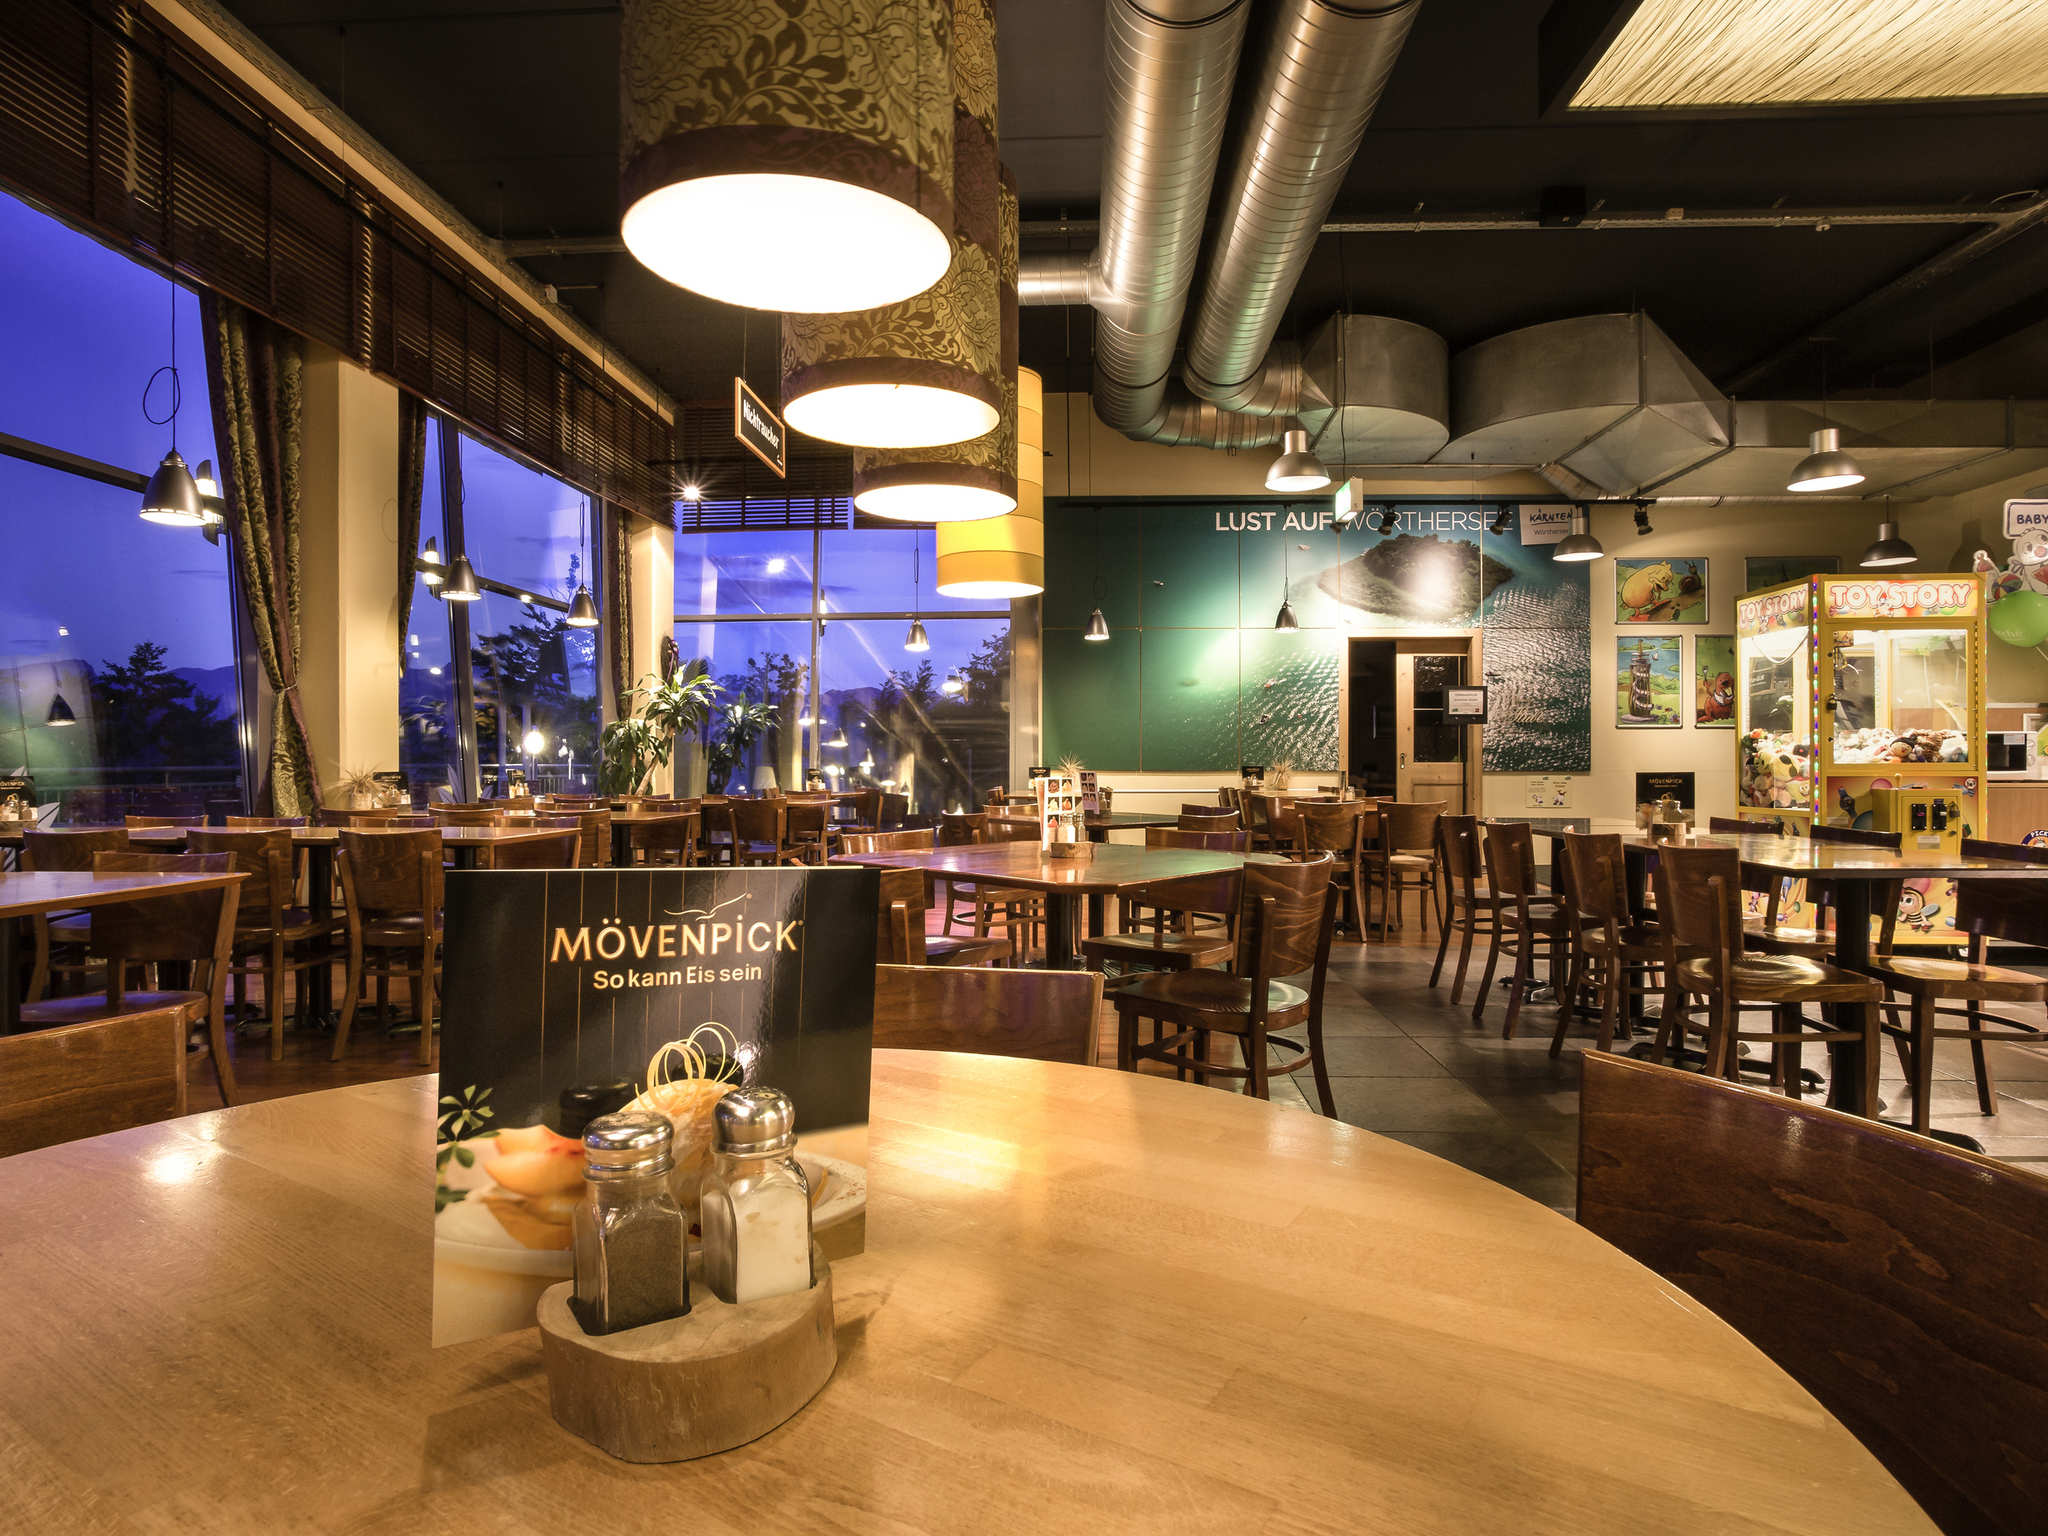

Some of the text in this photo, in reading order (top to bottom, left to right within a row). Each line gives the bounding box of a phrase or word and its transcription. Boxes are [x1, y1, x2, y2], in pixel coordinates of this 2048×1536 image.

[1215, 511, 1277, 531] LUST
[1282, 511, 1334, 531] AUF
[1740, 588, 1807, 623] TOY STORY
[1830, 583, 1972, 609] TOY STORY
[550, 914, 798, 963] MÖVENPICK
[593, 963, 763, 990] So kann Eis sein
